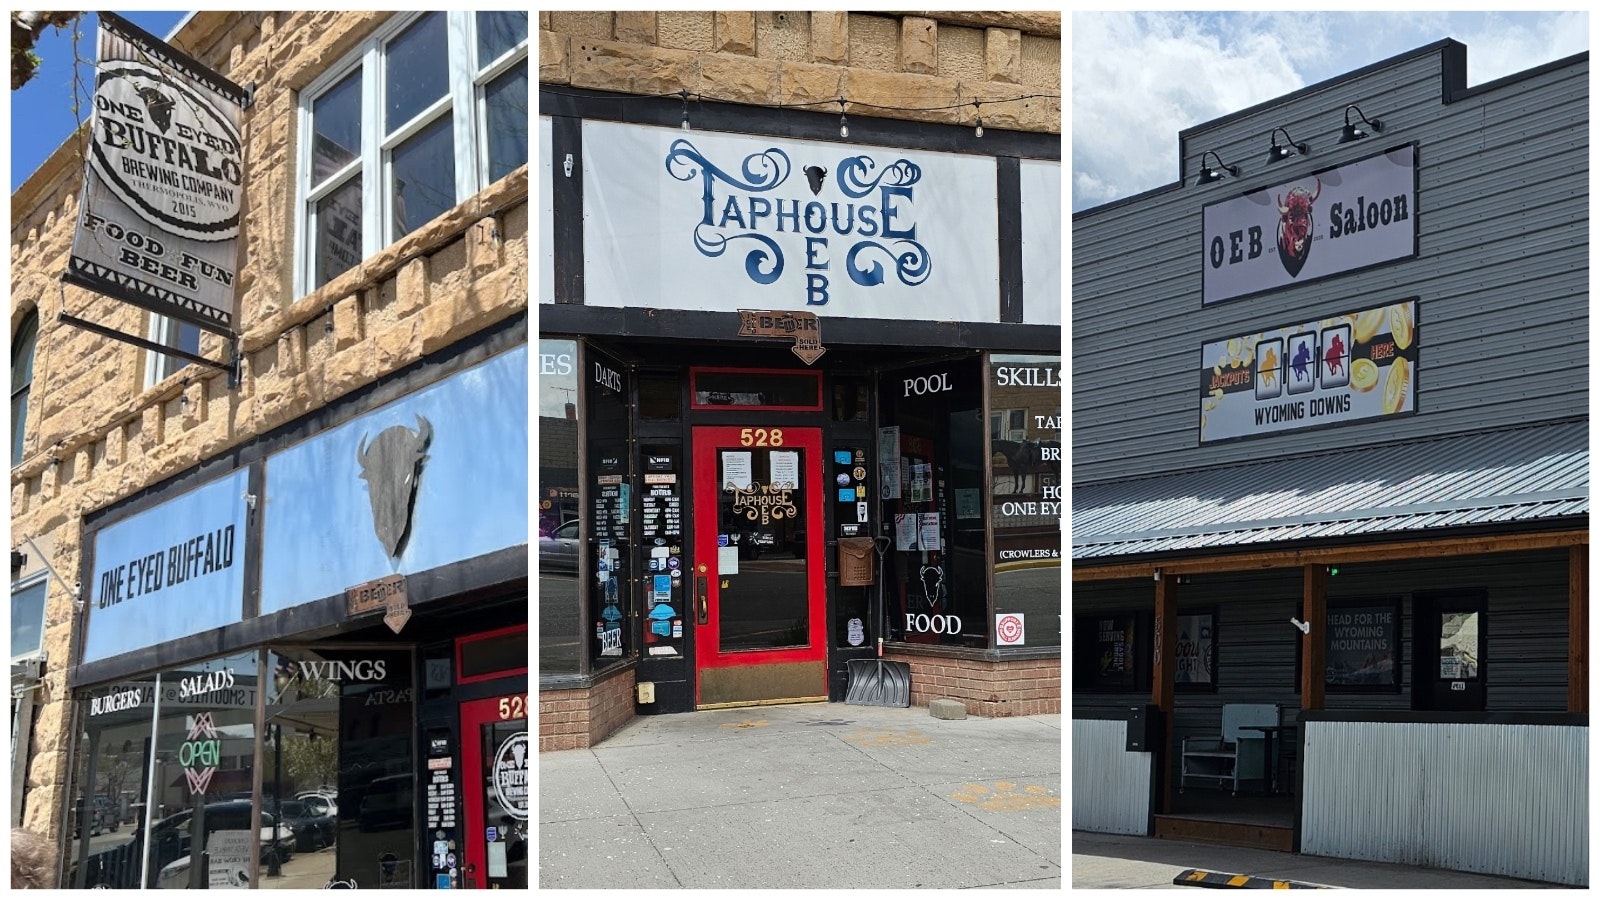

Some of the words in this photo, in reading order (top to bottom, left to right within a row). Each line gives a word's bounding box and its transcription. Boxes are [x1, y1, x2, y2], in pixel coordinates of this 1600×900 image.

[96, 95, 144, 124] ONE
[175, 122, 235, 155] EYED
[99, 116, 241, 186] BUFFALO
[122, 156, 179, 188] BREWING
[182, 174, 234, 205] COMPANY
[172, 201, 196, 218] 2015
[697, 160, 917, 241] TAPHOUSE
[1329, 193, 1409, 240] Saloon
[83, 213, 165, 257] FOOD
[180, 252, 234, 286] FUN
[119, 247, 198, 290] BEER
[1371, 341, 1395, 361] HERE
[595, 361, 622, 393] DARTS
[903, 372, 953, 397] POOL
[1209, 370, 1250, 390] JACKPOTS
[1254, 401, 1305, 426] WYOMING
[1310, 393, 1351, 417] DOWNS
[740, 428, 784, 447] 528
[1040, 447, 1062, 461] BR
[733, 488, 793, 506] TAPHOUSE
[1001, 502, 1037, 517] ONE
[1040, 501, 1062, 516] EY
[1000, 550, 1051, 559] (CROWLERS
[1051, 549, 1059, 558] &
[99, 564, 126, 610] ONE
[126, 550, 165, 600] EYED
[166, 524, 236, 588] BUFFALO
[905, 612, 963, 635] FOOD
[1327, 614, 1352, 626] HEAD
[1353, 613, 1373, 625] FOR
[1374, 612, 1393, 624] THE
[602, 627, 622, 653] BEER
[1334, 626, 1384, 638] WYOMING
[1330, 639, 1388, 651] MOUNTAINS
[298, 659, 387, 681] WINGS
[179, 668, 234, 698] SALADS
[90, 689, 142, 717] BURGERS
[179, 739, 221, 767] OPEN
